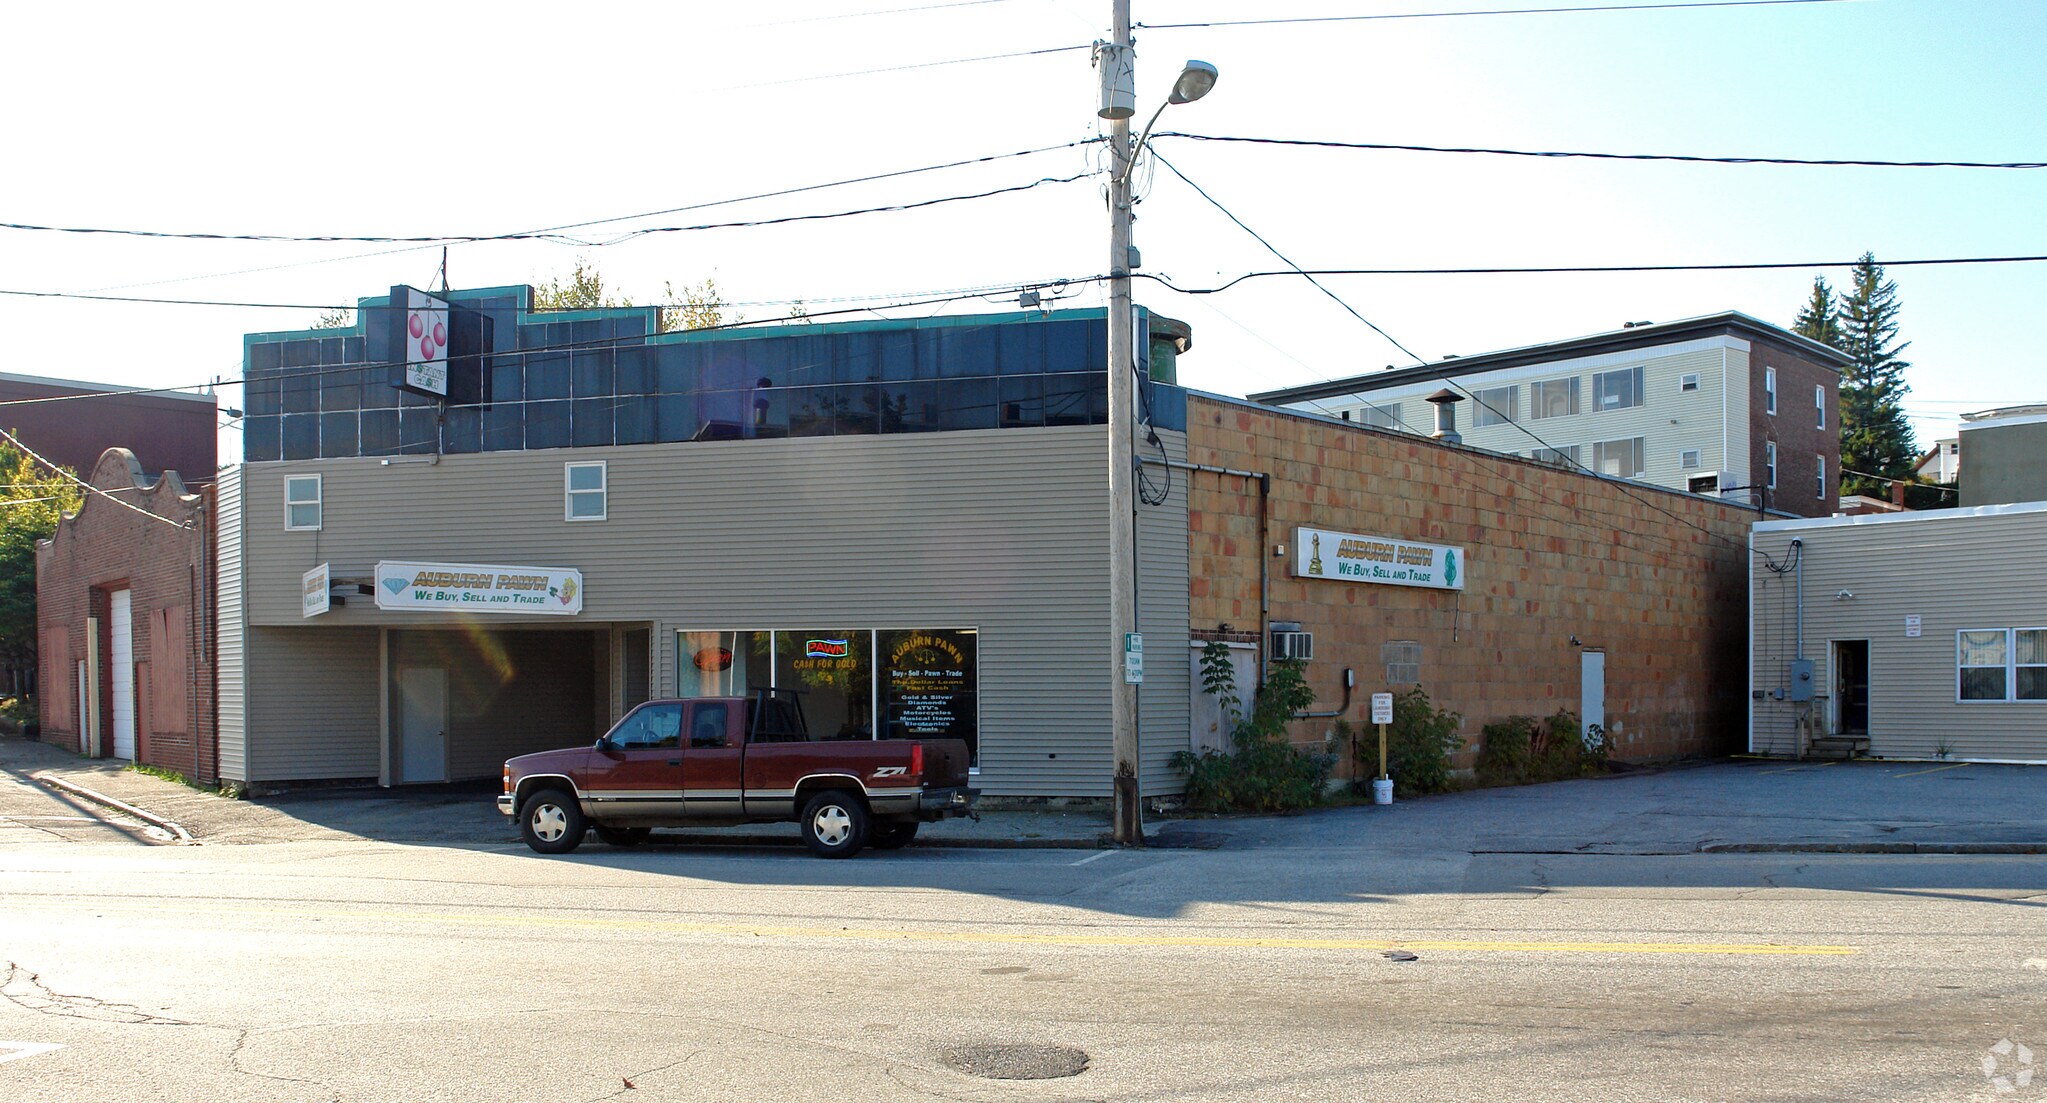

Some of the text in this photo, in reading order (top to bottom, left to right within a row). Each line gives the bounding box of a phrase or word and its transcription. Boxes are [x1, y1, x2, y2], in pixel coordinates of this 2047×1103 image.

[1336, 539, 1433, 567] AUBURN PAWN
[412, 571, 549, 591] AUBURN PAWN
[808, 642, 846, 655] PAWN
[892, 636, 963, 664] AUBURN PAWN
[817, 659, 833, 669] FOR
[836, 659, 857, 669] GOLD
[892, 670, 904, 678] Buy
[873, 766, 908, 778] Z71
